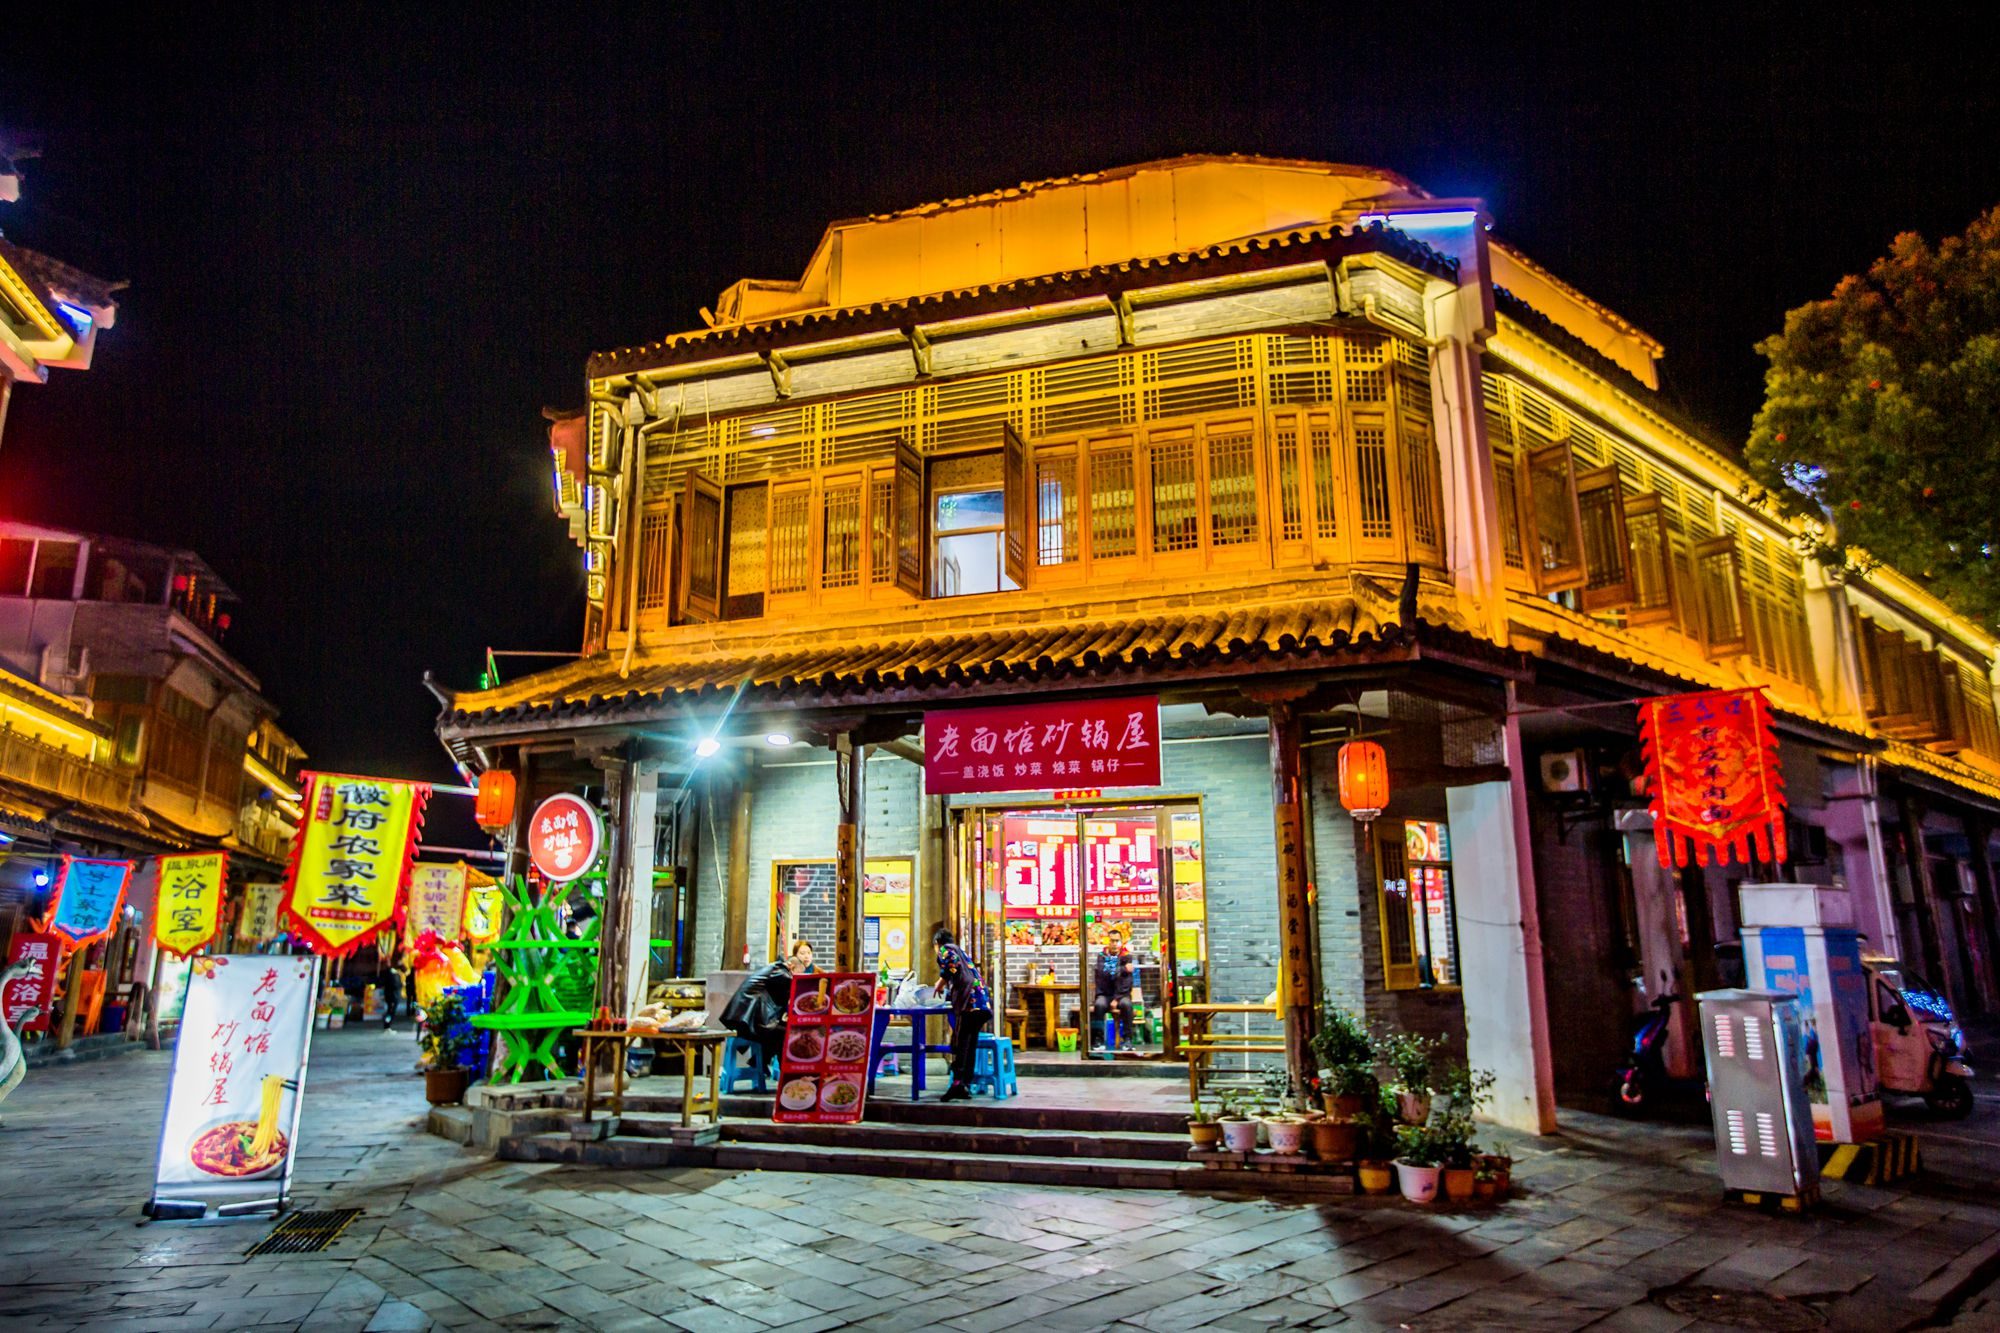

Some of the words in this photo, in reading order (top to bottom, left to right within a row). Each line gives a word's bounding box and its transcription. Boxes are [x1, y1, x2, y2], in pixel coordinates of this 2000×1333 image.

[933, 711, 1151, 762] 老面馆砂锅屋
[963, 763, 1004, 779] 盖浇饭
[1014, 761, 1043, 776] 炒菜
[1052, 759, 1081, 775] 烧菜
[1091, 758, 1120, 773] 锅仔
[169, 873, 207, 934] 浴室
[244, 967, 279, 1054] 老面馆
[201, 1020, 240, 1106] 砂锅屋
